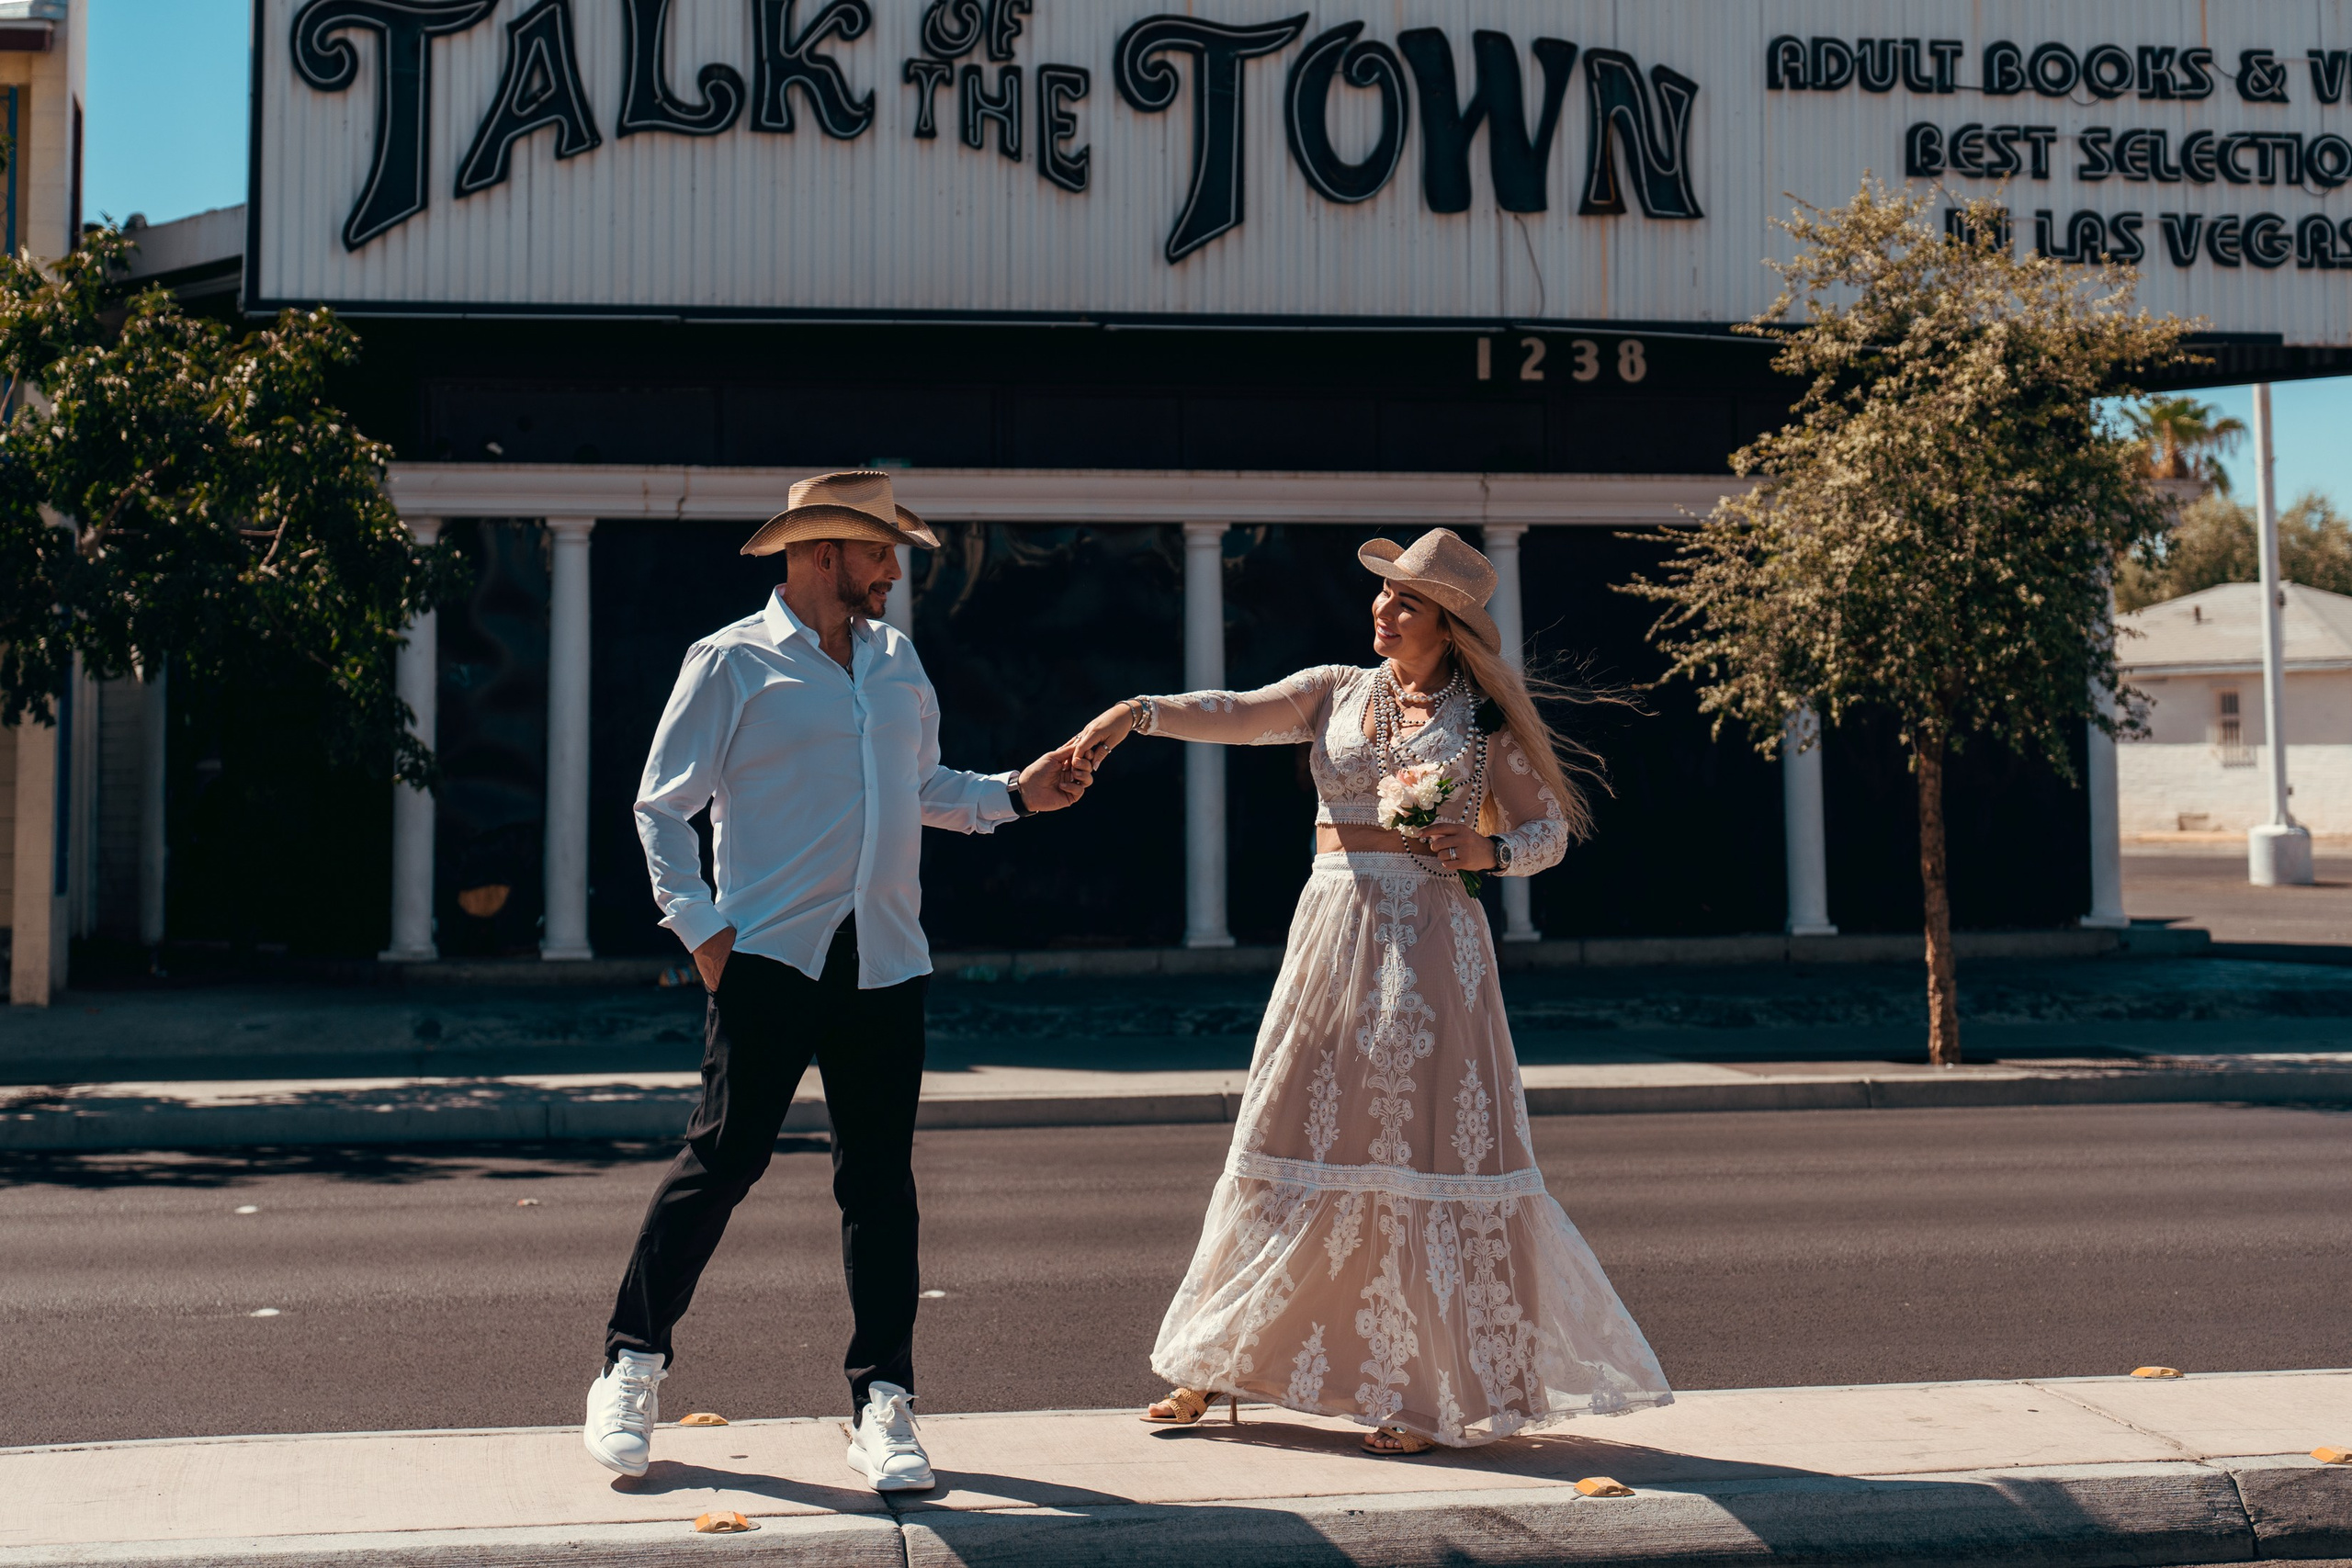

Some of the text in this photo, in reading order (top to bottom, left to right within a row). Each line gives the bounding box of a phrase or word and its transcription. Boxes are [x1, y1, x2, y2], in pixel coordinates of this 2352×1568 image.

[1766, 34, 1963, 93] ADULT
[1983, 39, 2214, 100] BOOKS
[2235, 49, 2290, 104] &
[289, 0, 1705, 265] TALK OF THE TOWN
[1905, 121, 2058, 180] BEST
[2034, 209, 2145, 265] LAS
[1476, 336, 1647, 383] 1238
